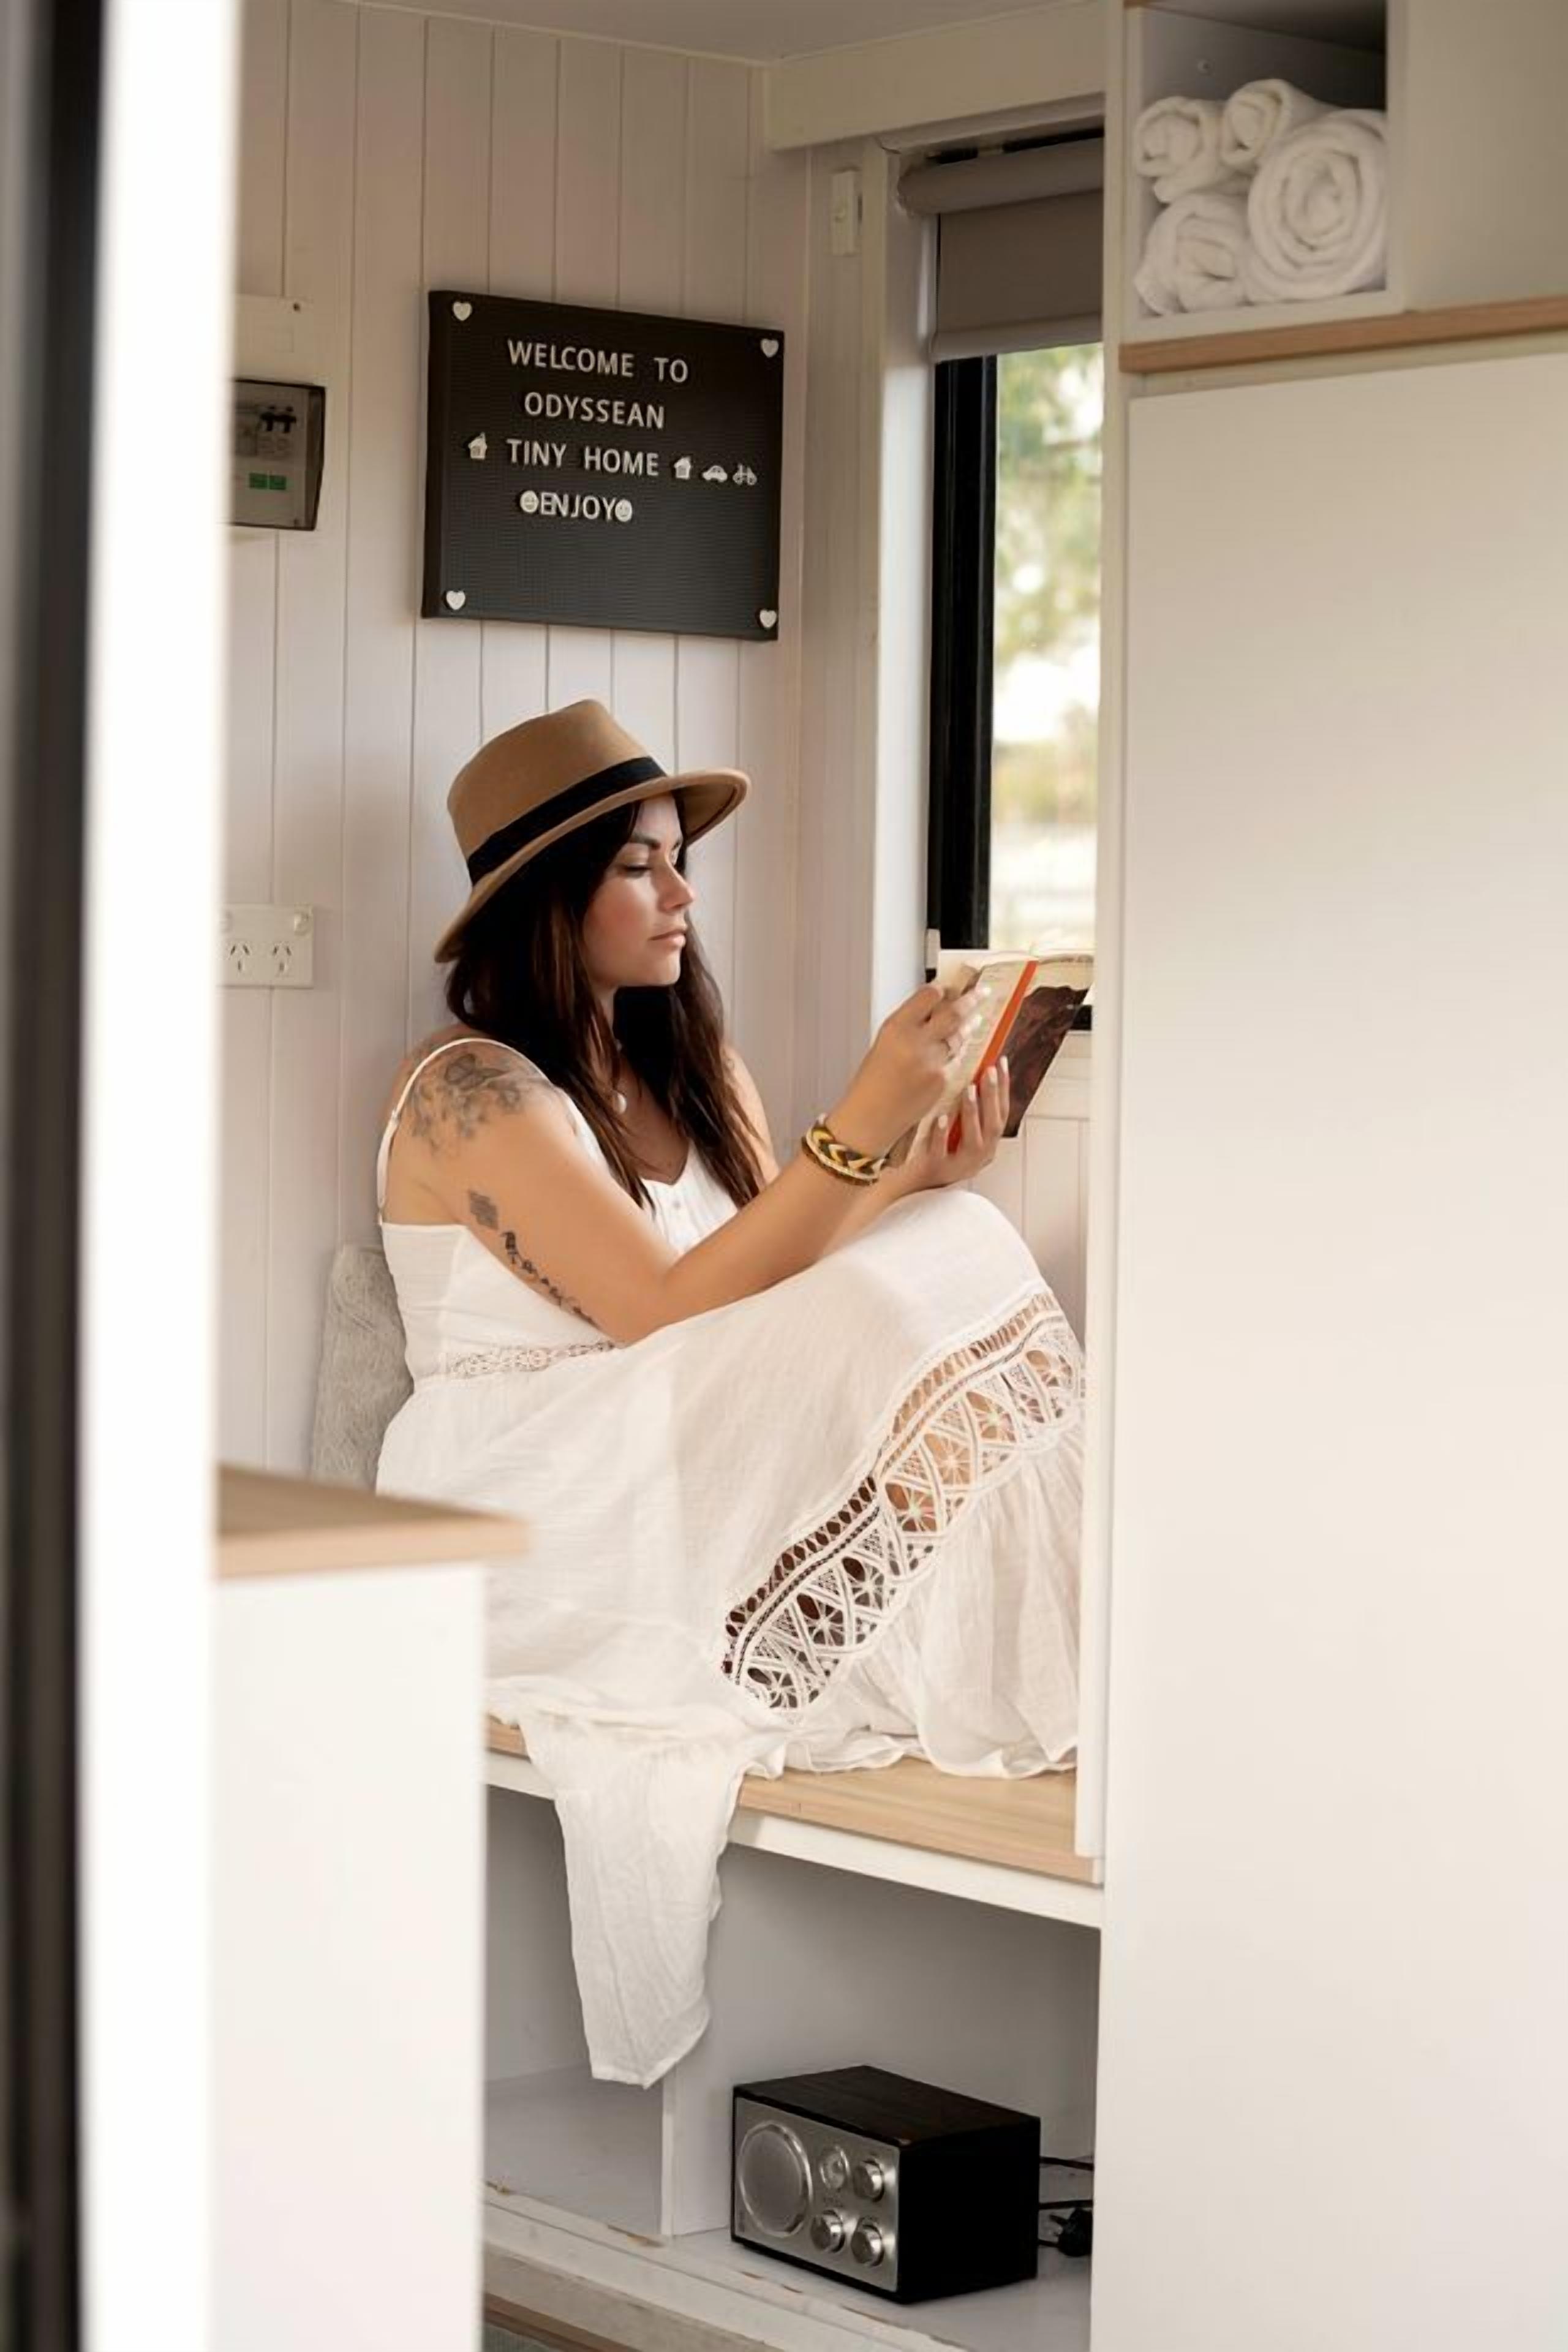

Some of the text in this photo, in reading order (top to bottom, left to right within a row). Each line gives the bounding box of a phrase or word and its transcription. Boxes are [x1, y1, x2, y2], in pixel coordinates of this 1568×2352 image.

[507, 339, 688, 382] WELCOME TO
[524, 392, 665, 429] ODYSSEAN
[507, 439, 659, 476] TINY HOME
[541, 492, 616, 521] ENJOY
